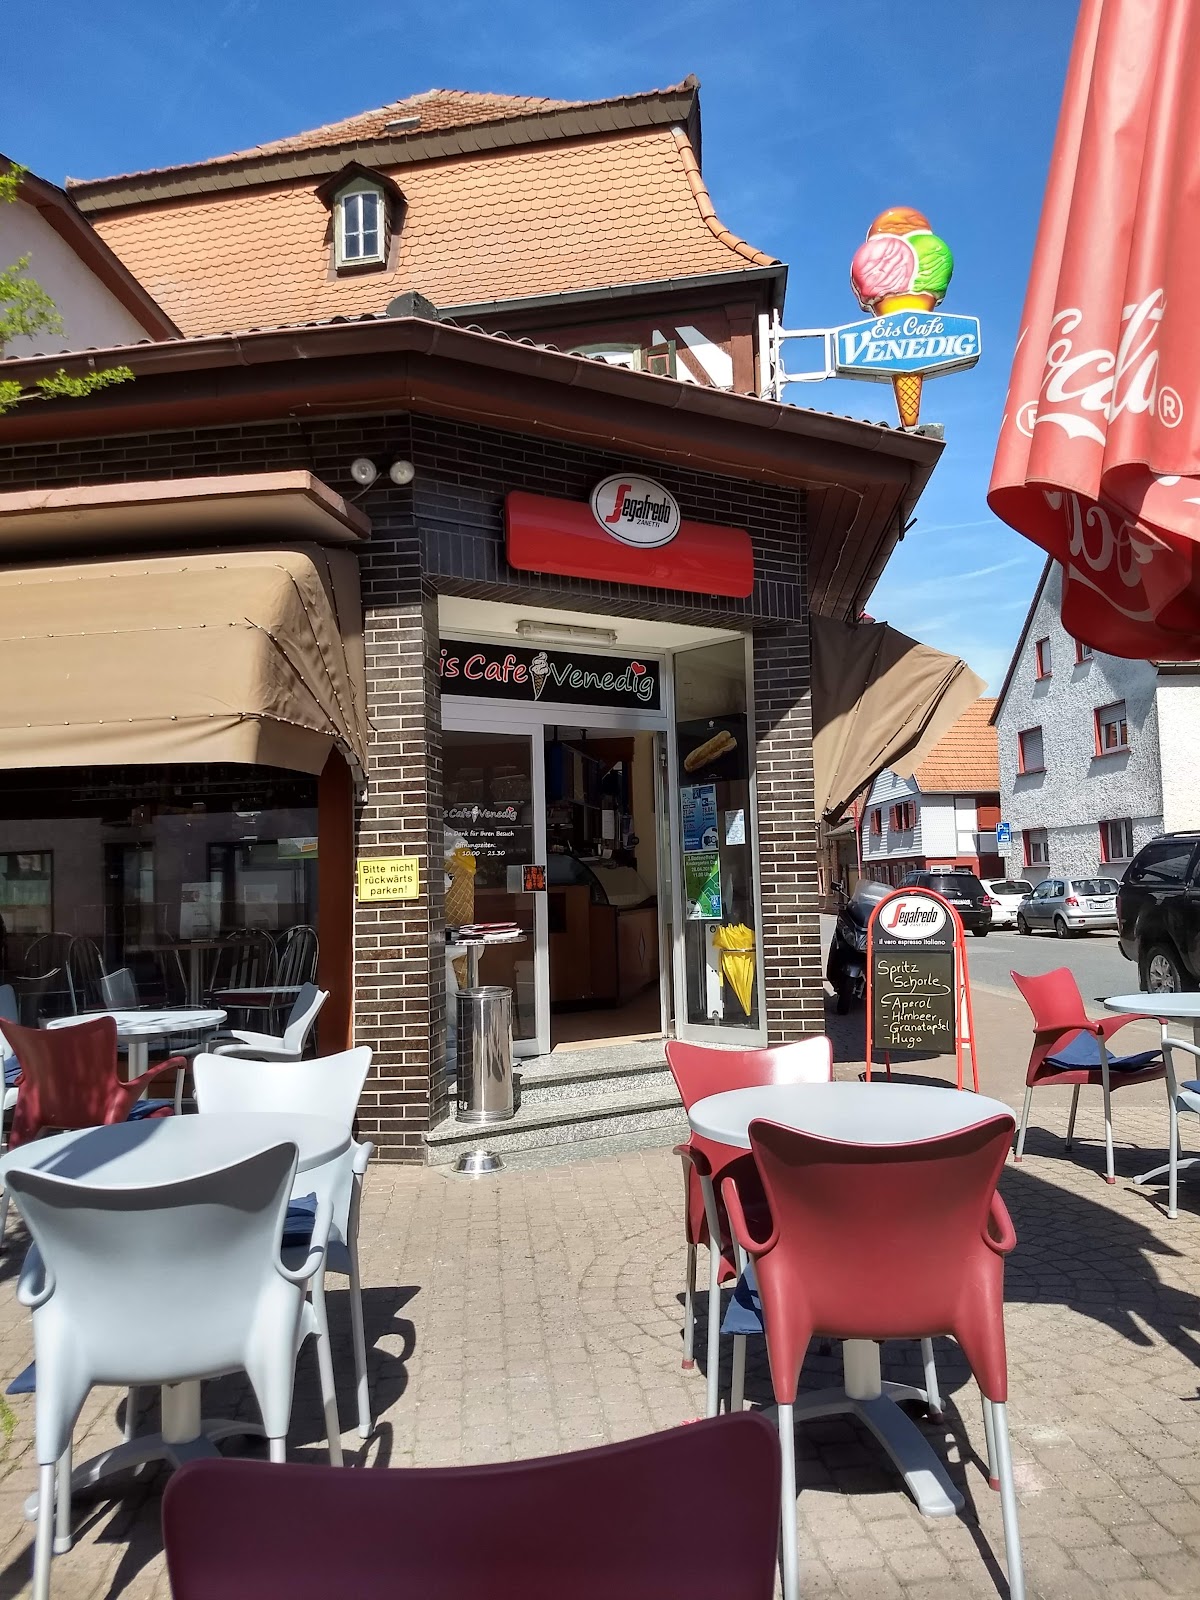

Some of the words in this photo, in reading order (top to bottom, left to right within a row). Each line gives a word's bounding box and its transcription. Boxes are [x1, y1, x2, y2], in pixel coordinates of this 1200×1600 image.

[871, 318, 902, 338] Eis
[902, 316, 945, 338] Cafe
[840, 330, 977, 365] VENEDIG
[605, 484, 671, 524] Segafredo
[636, 519, 661, 528] ZANETTI
[440, 649, 460, 677] is
[464, 654, 528, 683] Cafe
[549, 661, 654, 701] Venedig
[449, 807, 472, 818] Cafe
[478, 806, 518, 821] Venedig
[362, 865, 386, 874] Bitte
[390, 863, 414, 872] nicht
[364, 875, 413, 884] rückwärts
[370, 885, 408, 896] parken!
[887, 903, 938, 928] Segafredo
[877, 960, 919, 982] Spritz
[894, 973, 941, 994] Schorle
[892, 997, 931, 1014] Aperol
[892, 1010, 937, 1022] Himbeer
[890, 1018, 950, 1036] Granatapfel
[892, 1033, 922, 1048] Hugo
